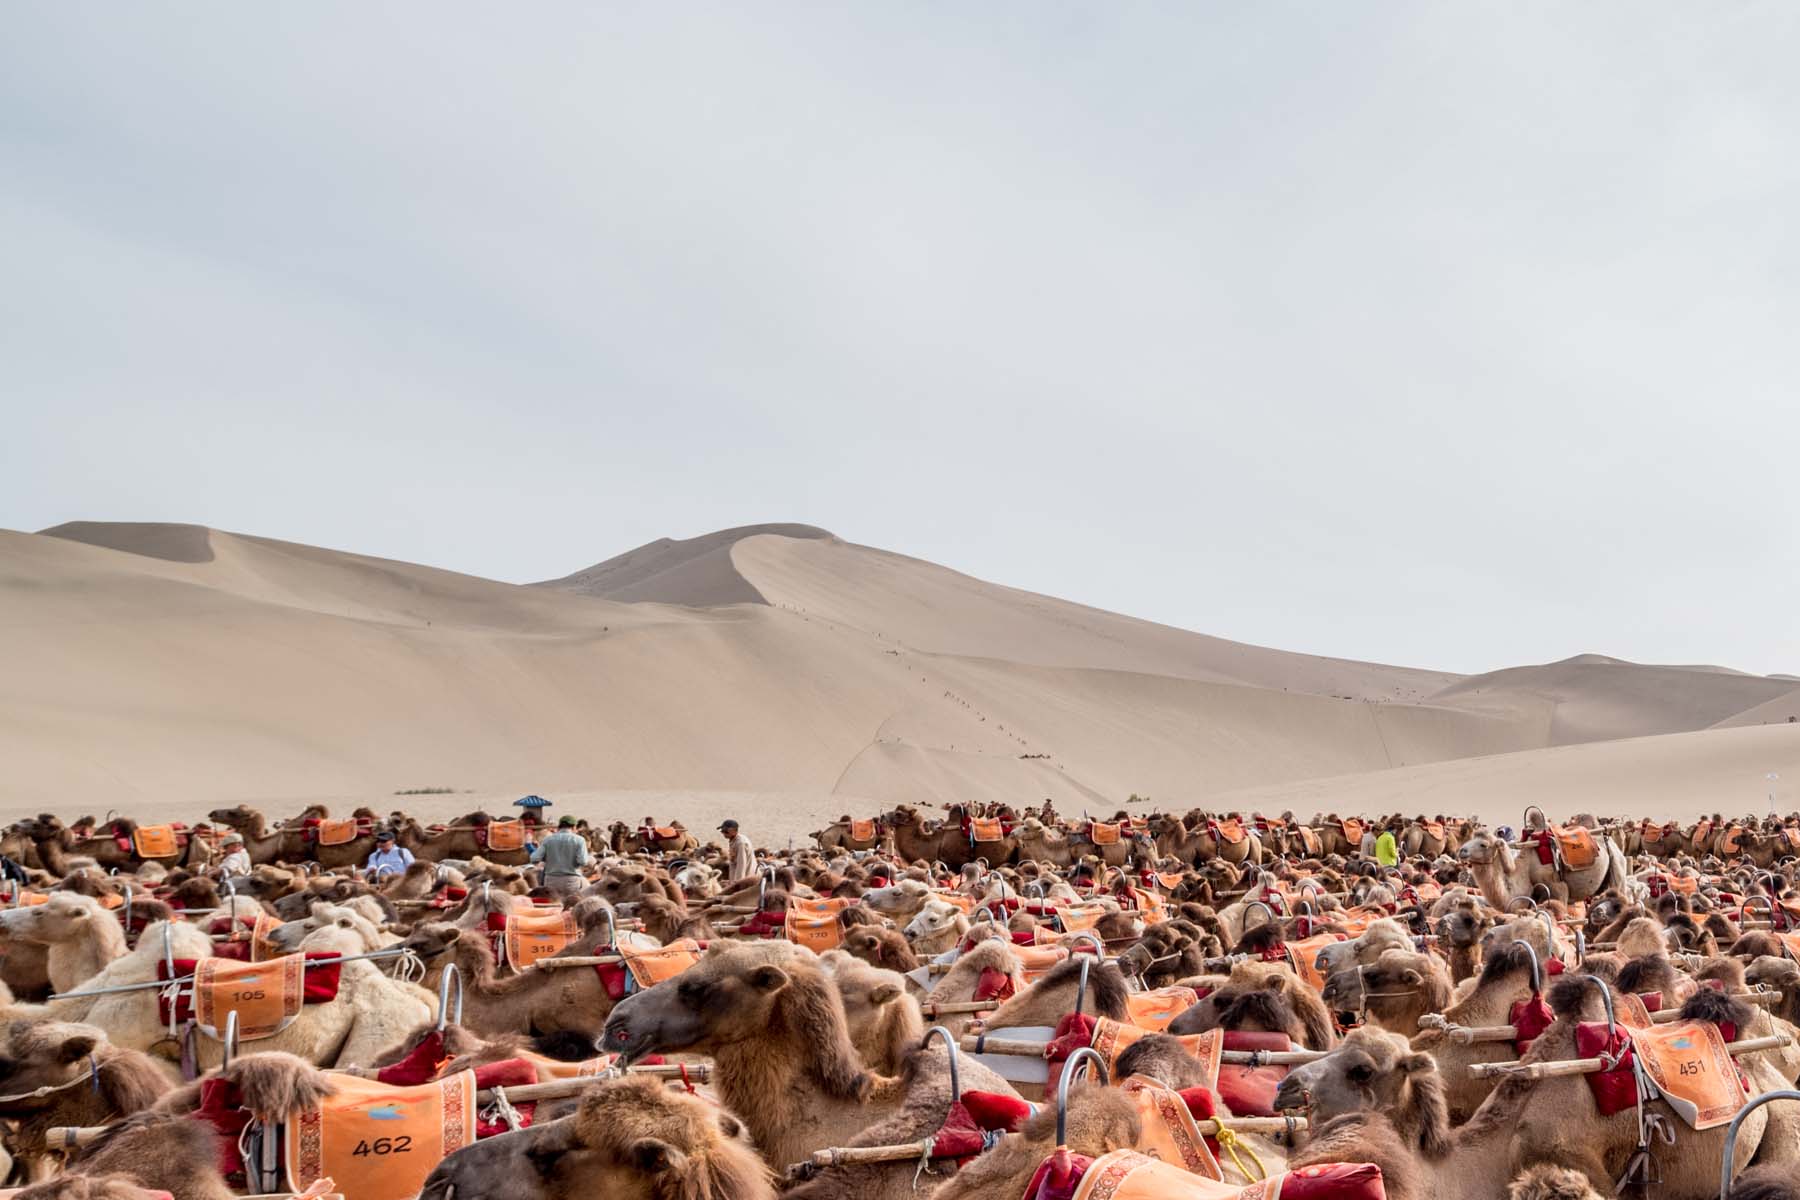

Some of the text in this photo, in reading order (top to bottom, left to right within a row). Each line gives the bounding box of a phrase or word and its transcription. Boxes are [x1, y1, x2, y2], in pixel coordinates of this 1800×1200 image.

[231, 990, 265, 1003] 105
[1679, 1059, 1706, 1077] 451
[351, 1135, 412, 1157] 462
